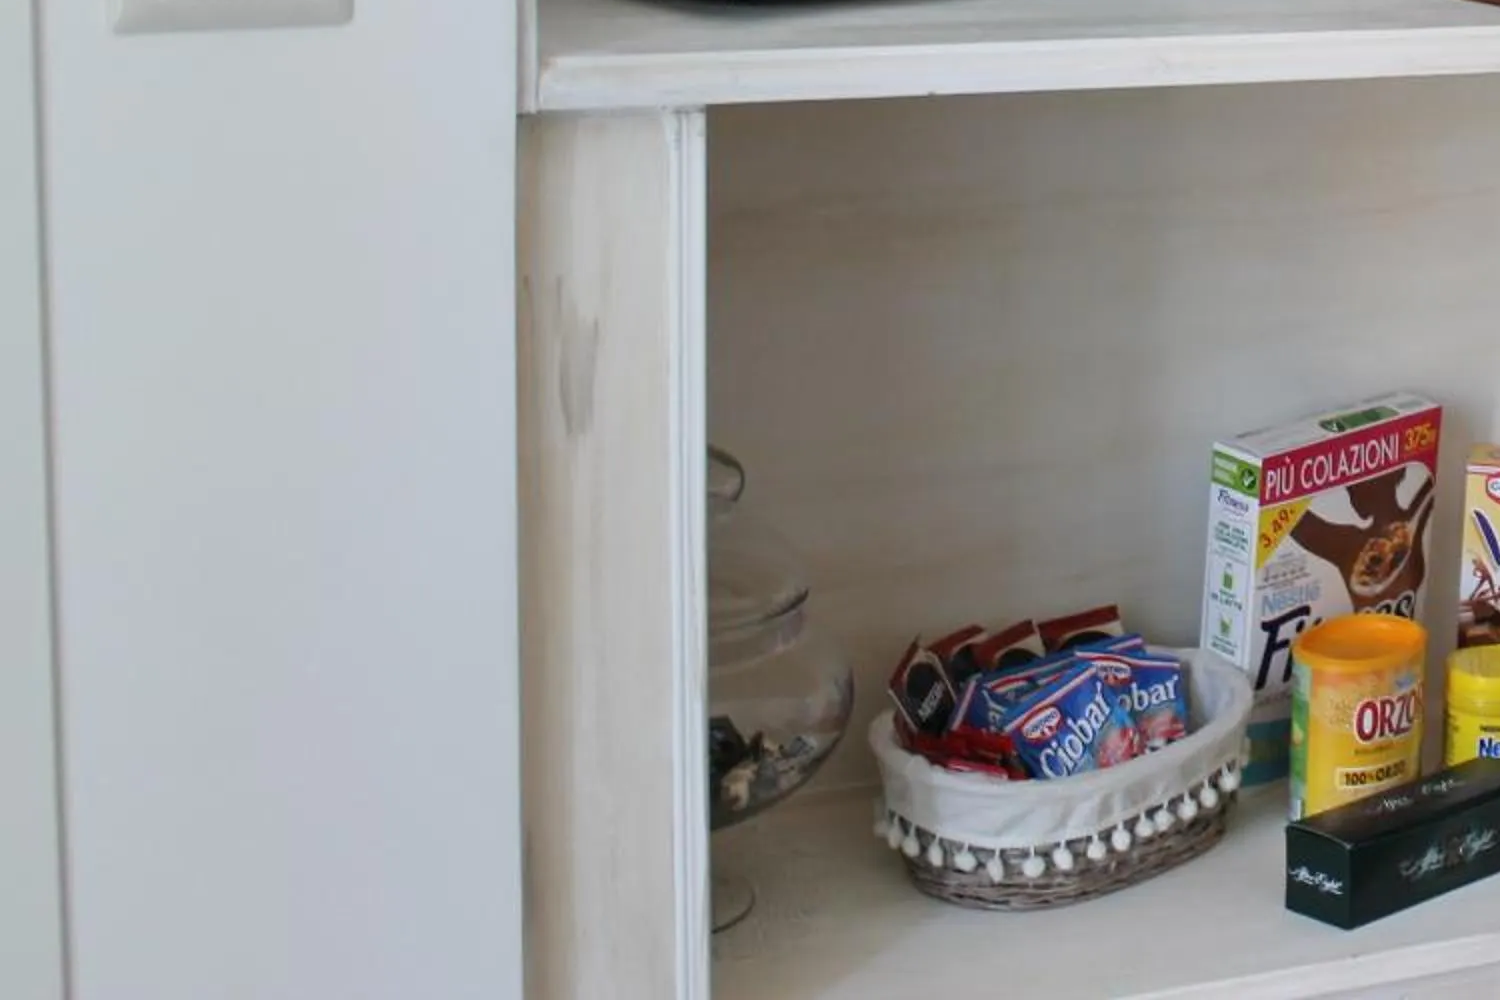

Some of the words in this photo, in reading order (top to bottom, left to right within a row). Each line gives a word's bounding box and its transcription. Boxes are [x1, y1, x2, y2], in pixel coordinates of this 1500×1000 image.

[1265, 457, 1296, 500] PIÙ
[1300, 432, 1400, 489] COLAZIONI
[1118, 673, 1179, 712] obar
[1039, 682, 1111, 778] Ciobar
